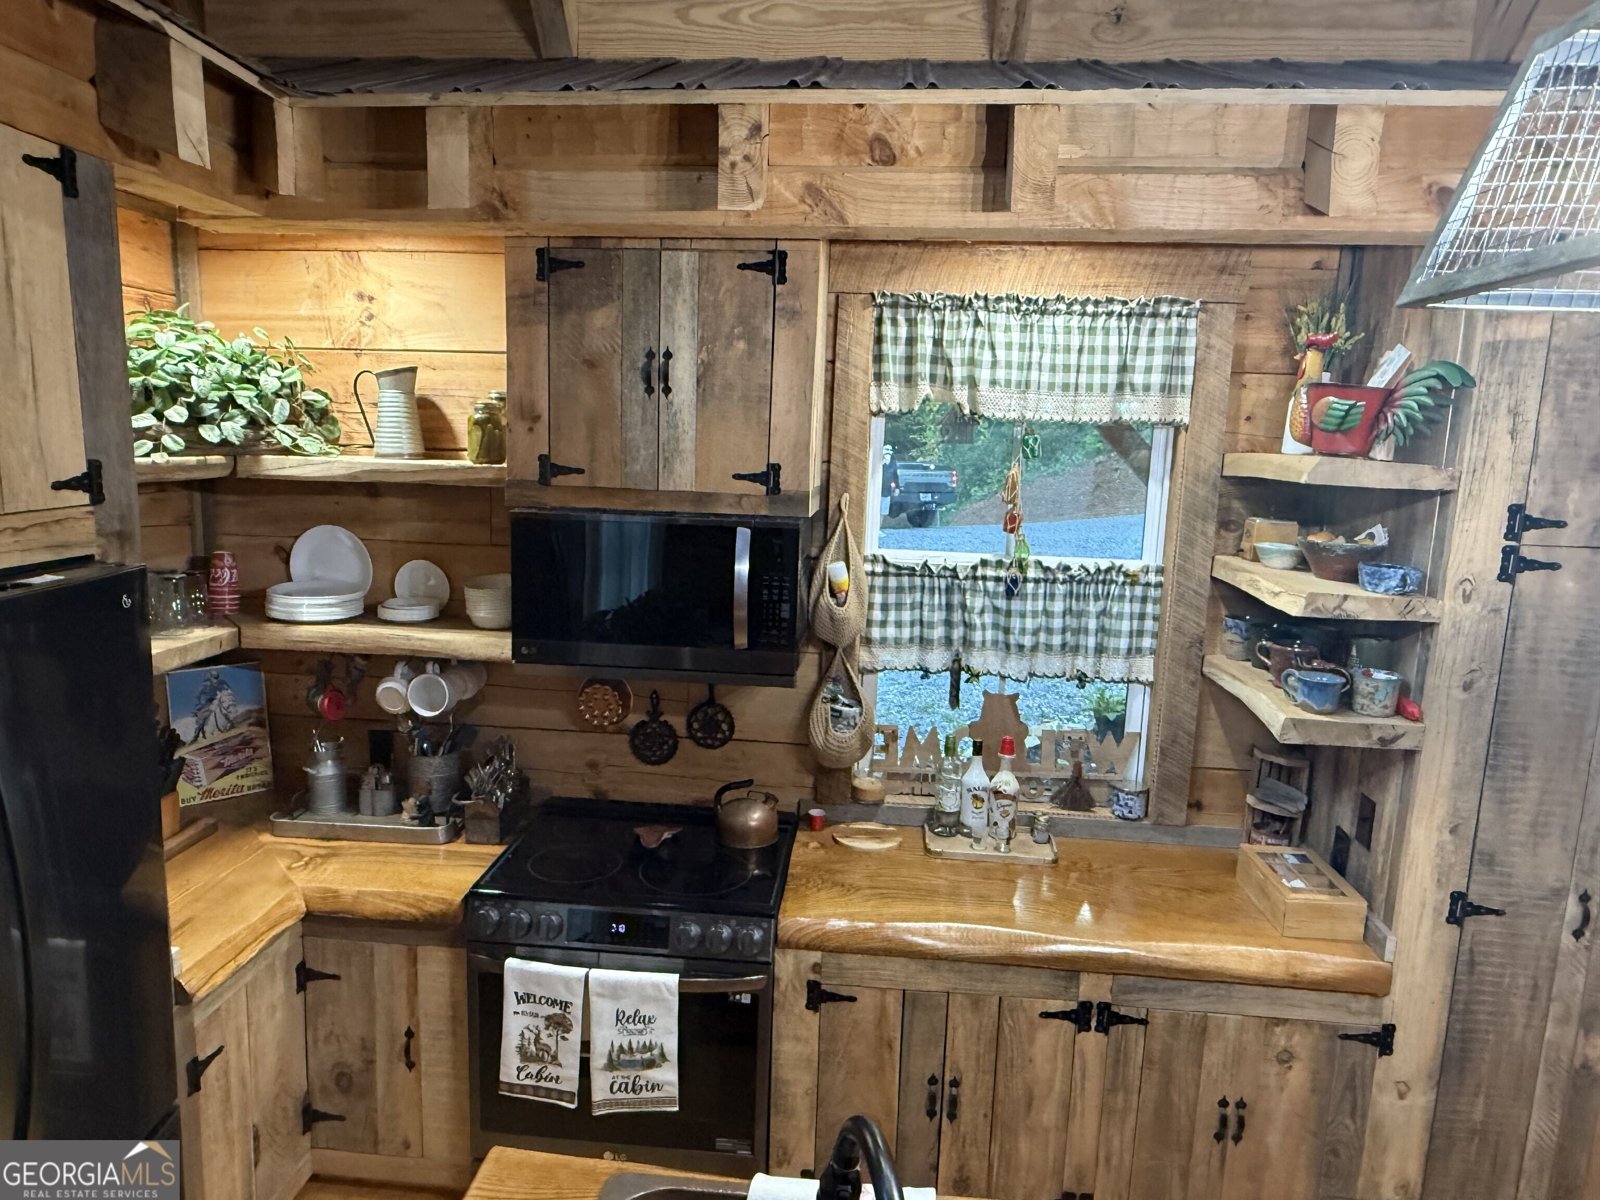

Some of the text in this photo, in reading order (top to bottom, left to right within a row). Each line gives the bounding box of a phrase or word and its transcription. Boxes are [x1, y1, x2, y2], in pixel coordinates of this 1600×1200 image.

[180, 796, 197, 805] BUY
[513, 991, 574, 1015] WELCOME
[615, 1007, 658, 1027] Relax
[516, 1064, 563, 1085] Cabin
[609, 1074, 664, 1096] cabin
